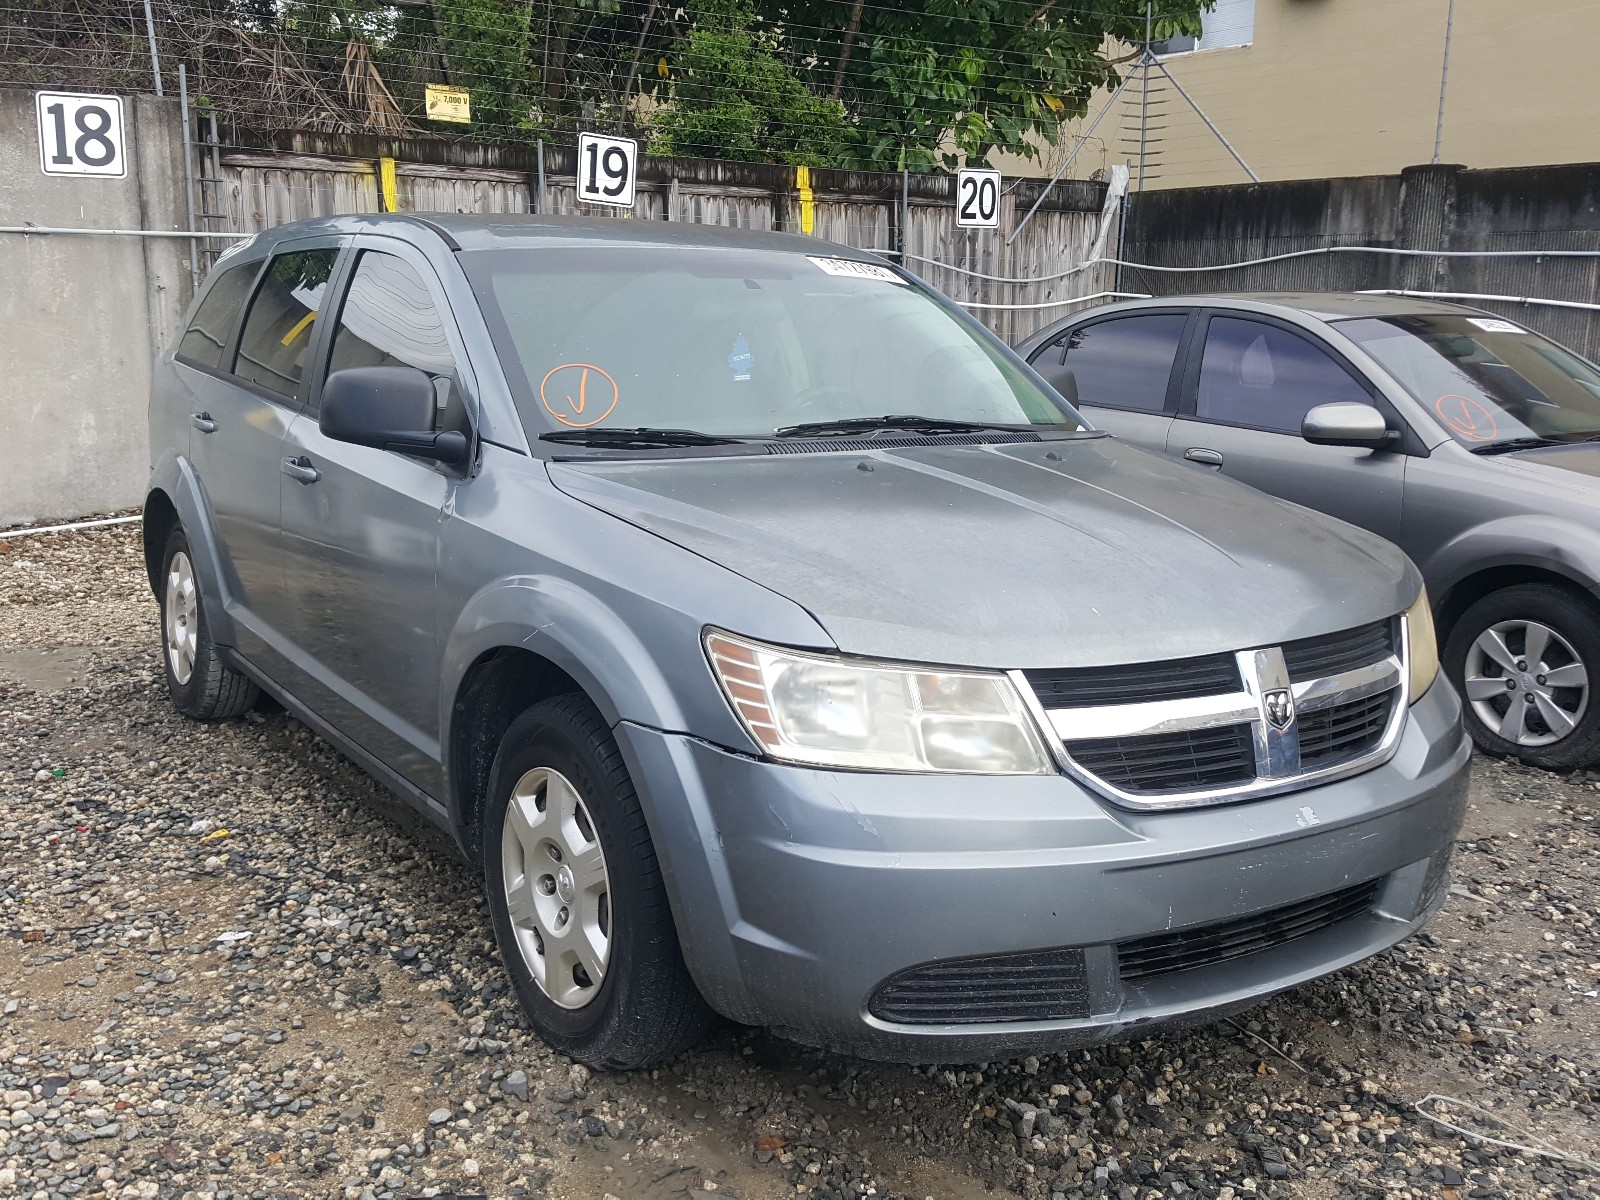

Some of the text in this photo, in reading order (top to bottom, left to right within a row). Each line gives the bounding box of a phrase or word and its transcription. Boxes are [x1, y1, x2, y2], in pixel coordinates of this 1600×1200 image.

[443, 95, 468, 105] 7,000 V
[47, 103, 116, 167] 18
[585, 143, 628, 196] 19
[960, 176, 996, 220] 20
